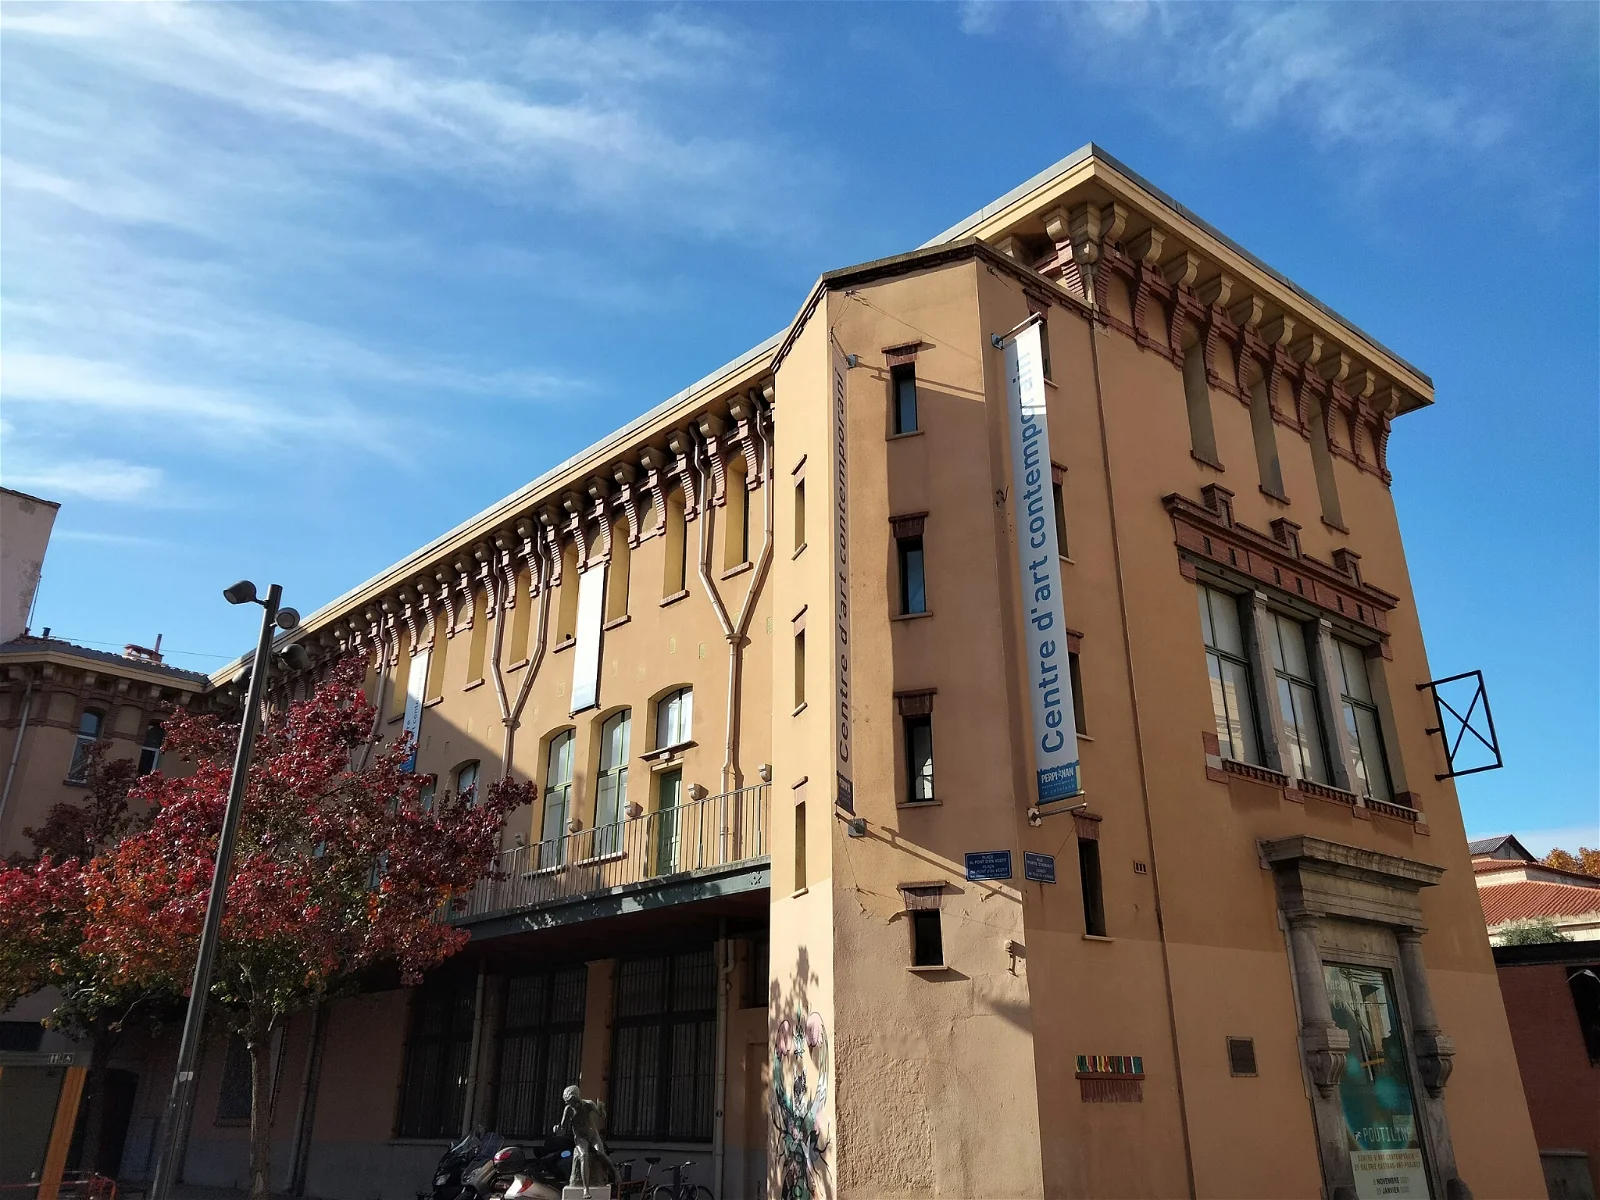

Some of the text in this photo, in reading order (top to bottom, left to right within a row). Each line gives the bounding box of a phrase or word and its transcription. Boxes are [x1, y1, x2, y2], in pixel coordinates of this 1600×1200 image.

[1013, 351, 1047, 549] contemporain
[838, 572, 848, 645] d'art
[1028, 554, 1053, 631] d'art
[839, 654, 849, 763] Centre
[1038, 640, 1065, 754] Centre
[1376, 1177, 1399, 1185] NOVEMBRE
[1382, 1186, 1399, 1194] JANVIER
